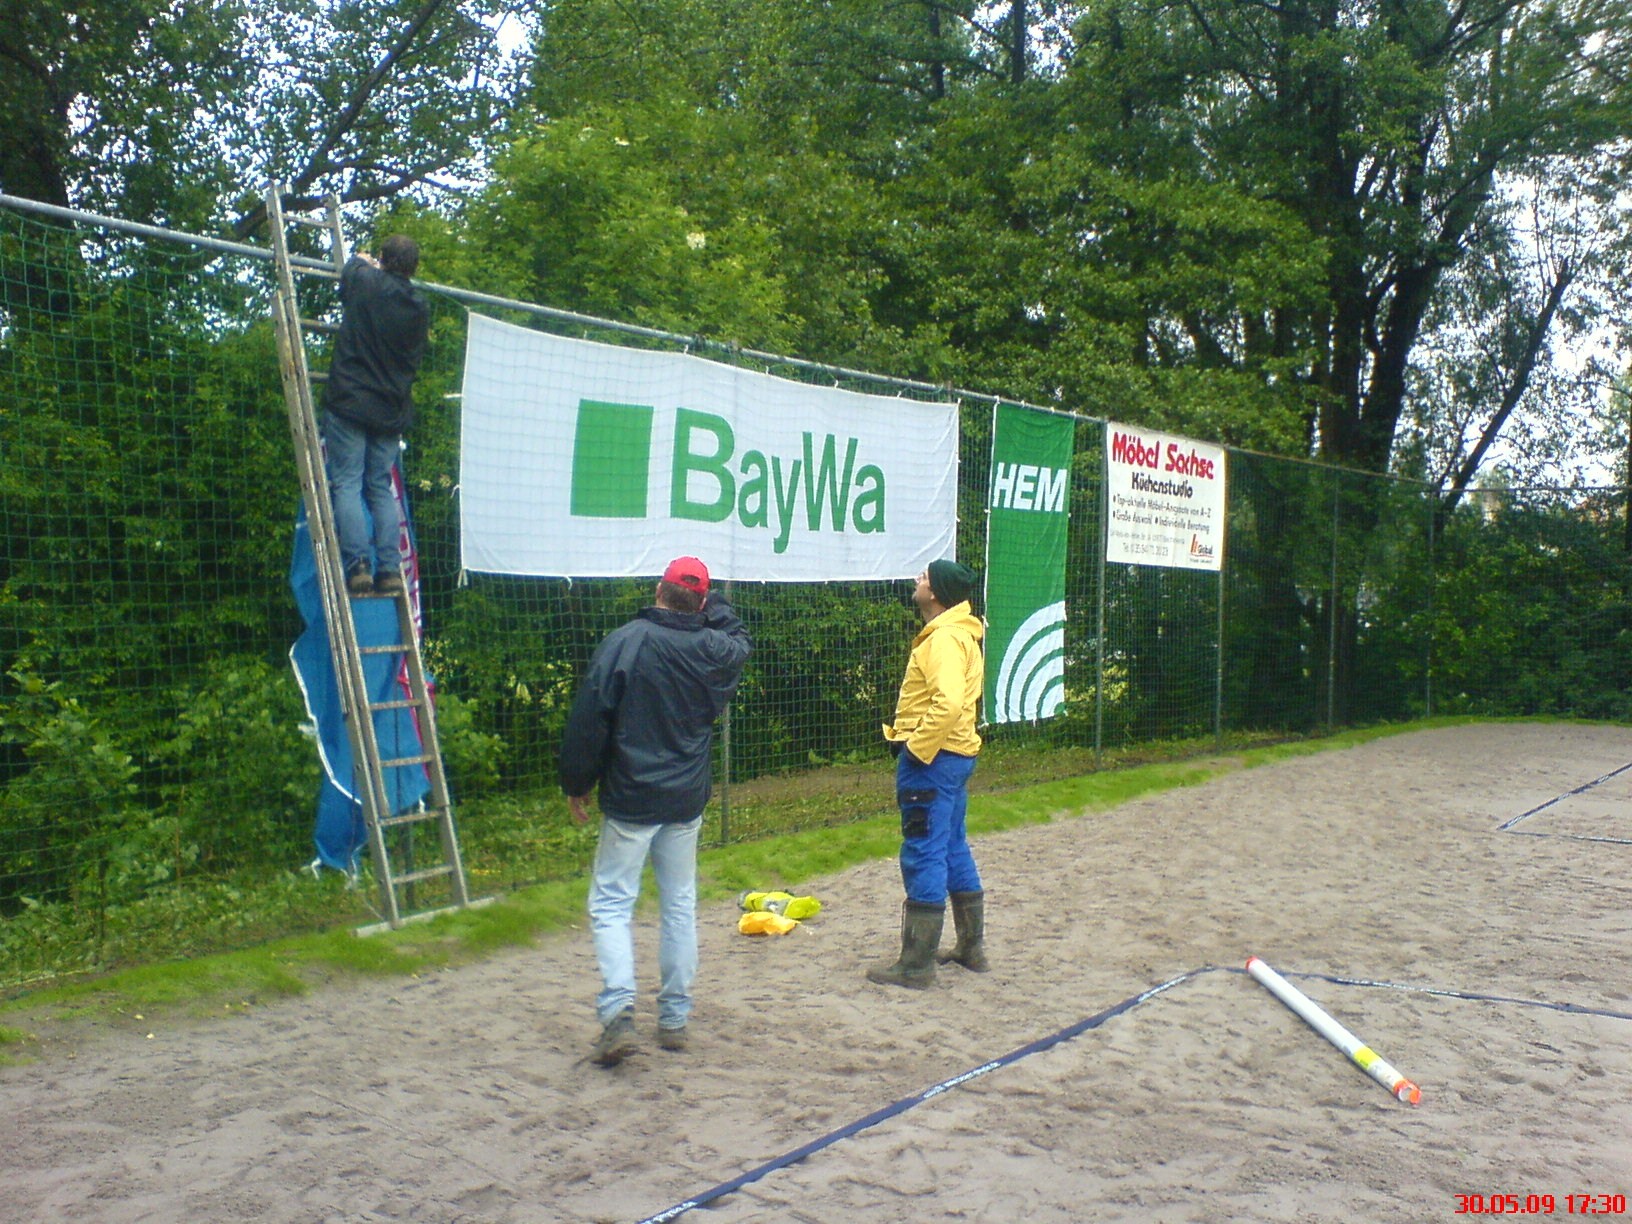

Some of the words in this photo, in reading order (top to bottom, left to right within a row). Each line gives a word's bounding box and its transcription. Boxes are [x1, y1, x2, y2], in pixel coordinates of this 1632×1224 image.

[1112, 432, 1160, 469] Möbel
[670, 407, 886, 554] BayWa
[992, 462, 1069, 512] HEM
[1131, 471, 1193, 499] Küchenstudio
